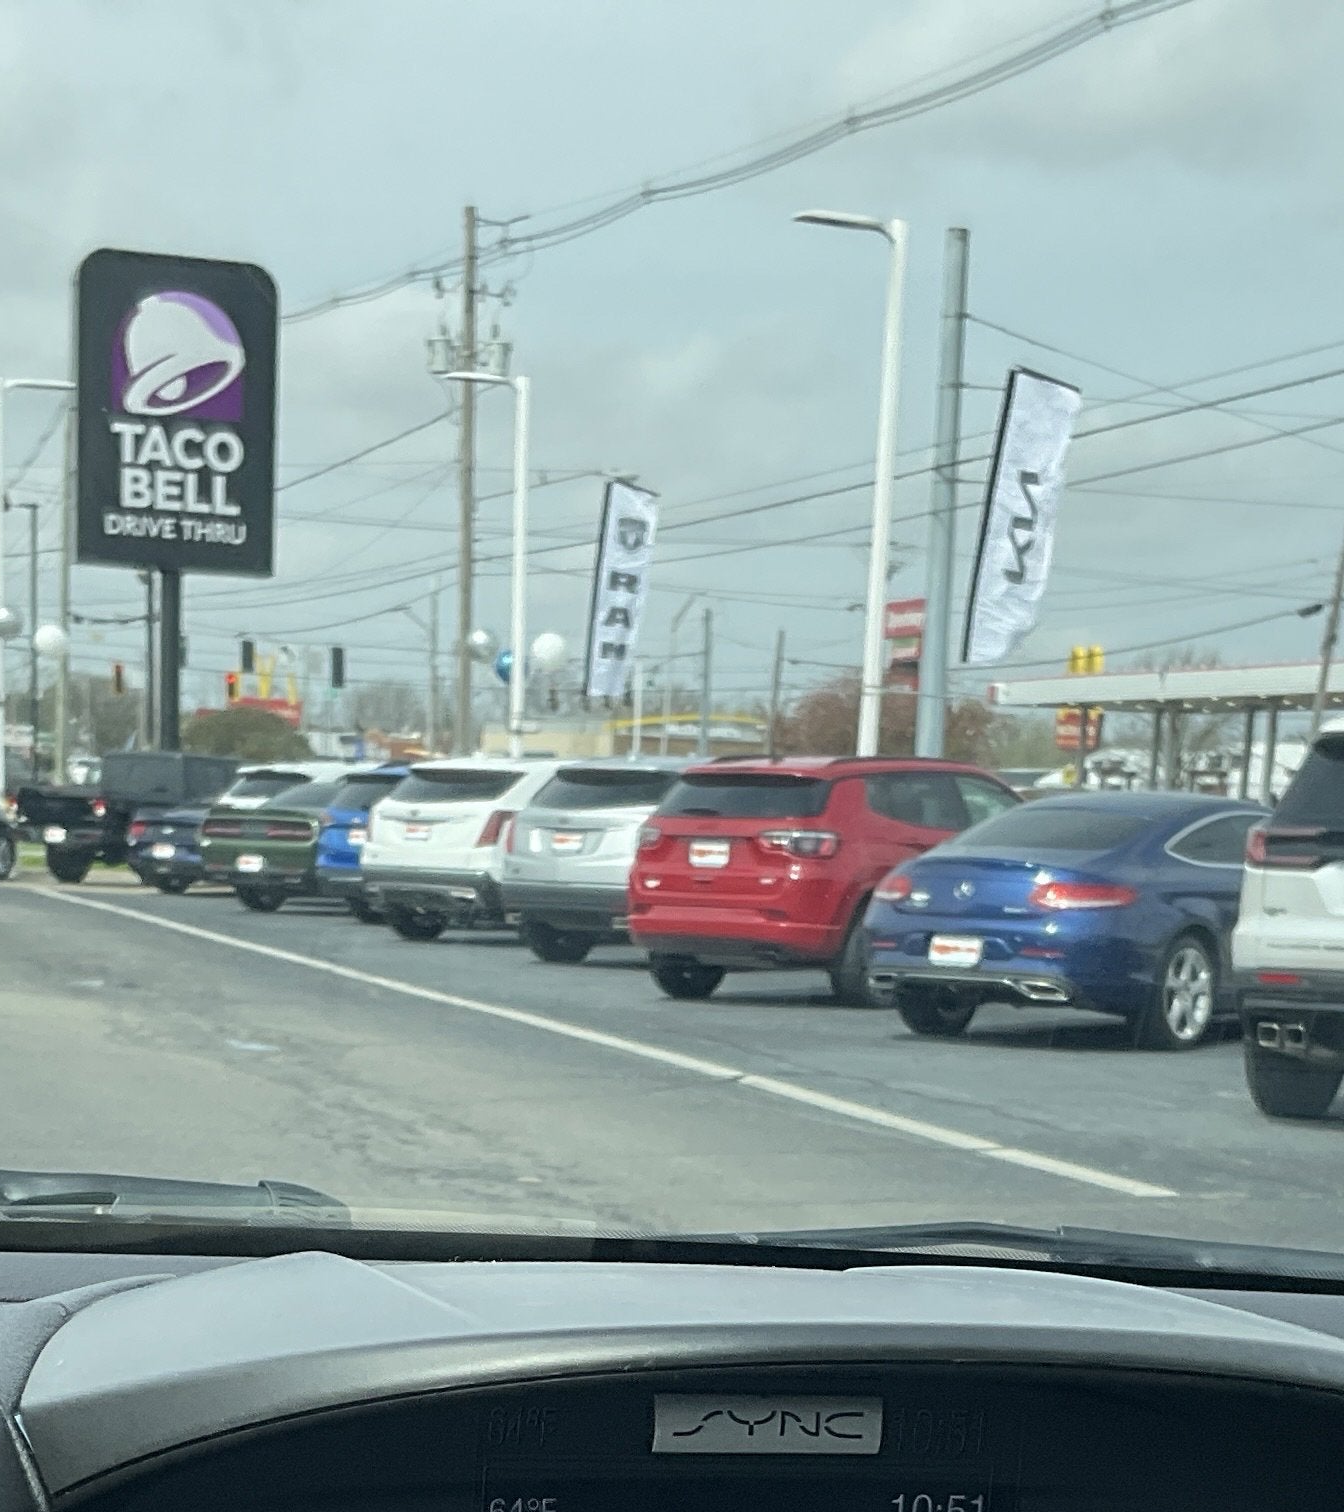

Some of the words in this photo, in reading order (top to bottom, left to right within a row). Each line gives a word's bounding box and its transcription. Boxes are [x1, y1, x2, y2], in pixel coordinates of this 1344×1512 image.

[110, 421, 244, 473] TACO
[120, 465, 241, 516] BELL
[103, 513, 177, 539] DRIVE
[180, 519, 247, 545] THRU
[1003, 468, 1040, 585] KIA
[672, 1409, 864, 1439] SYNC
